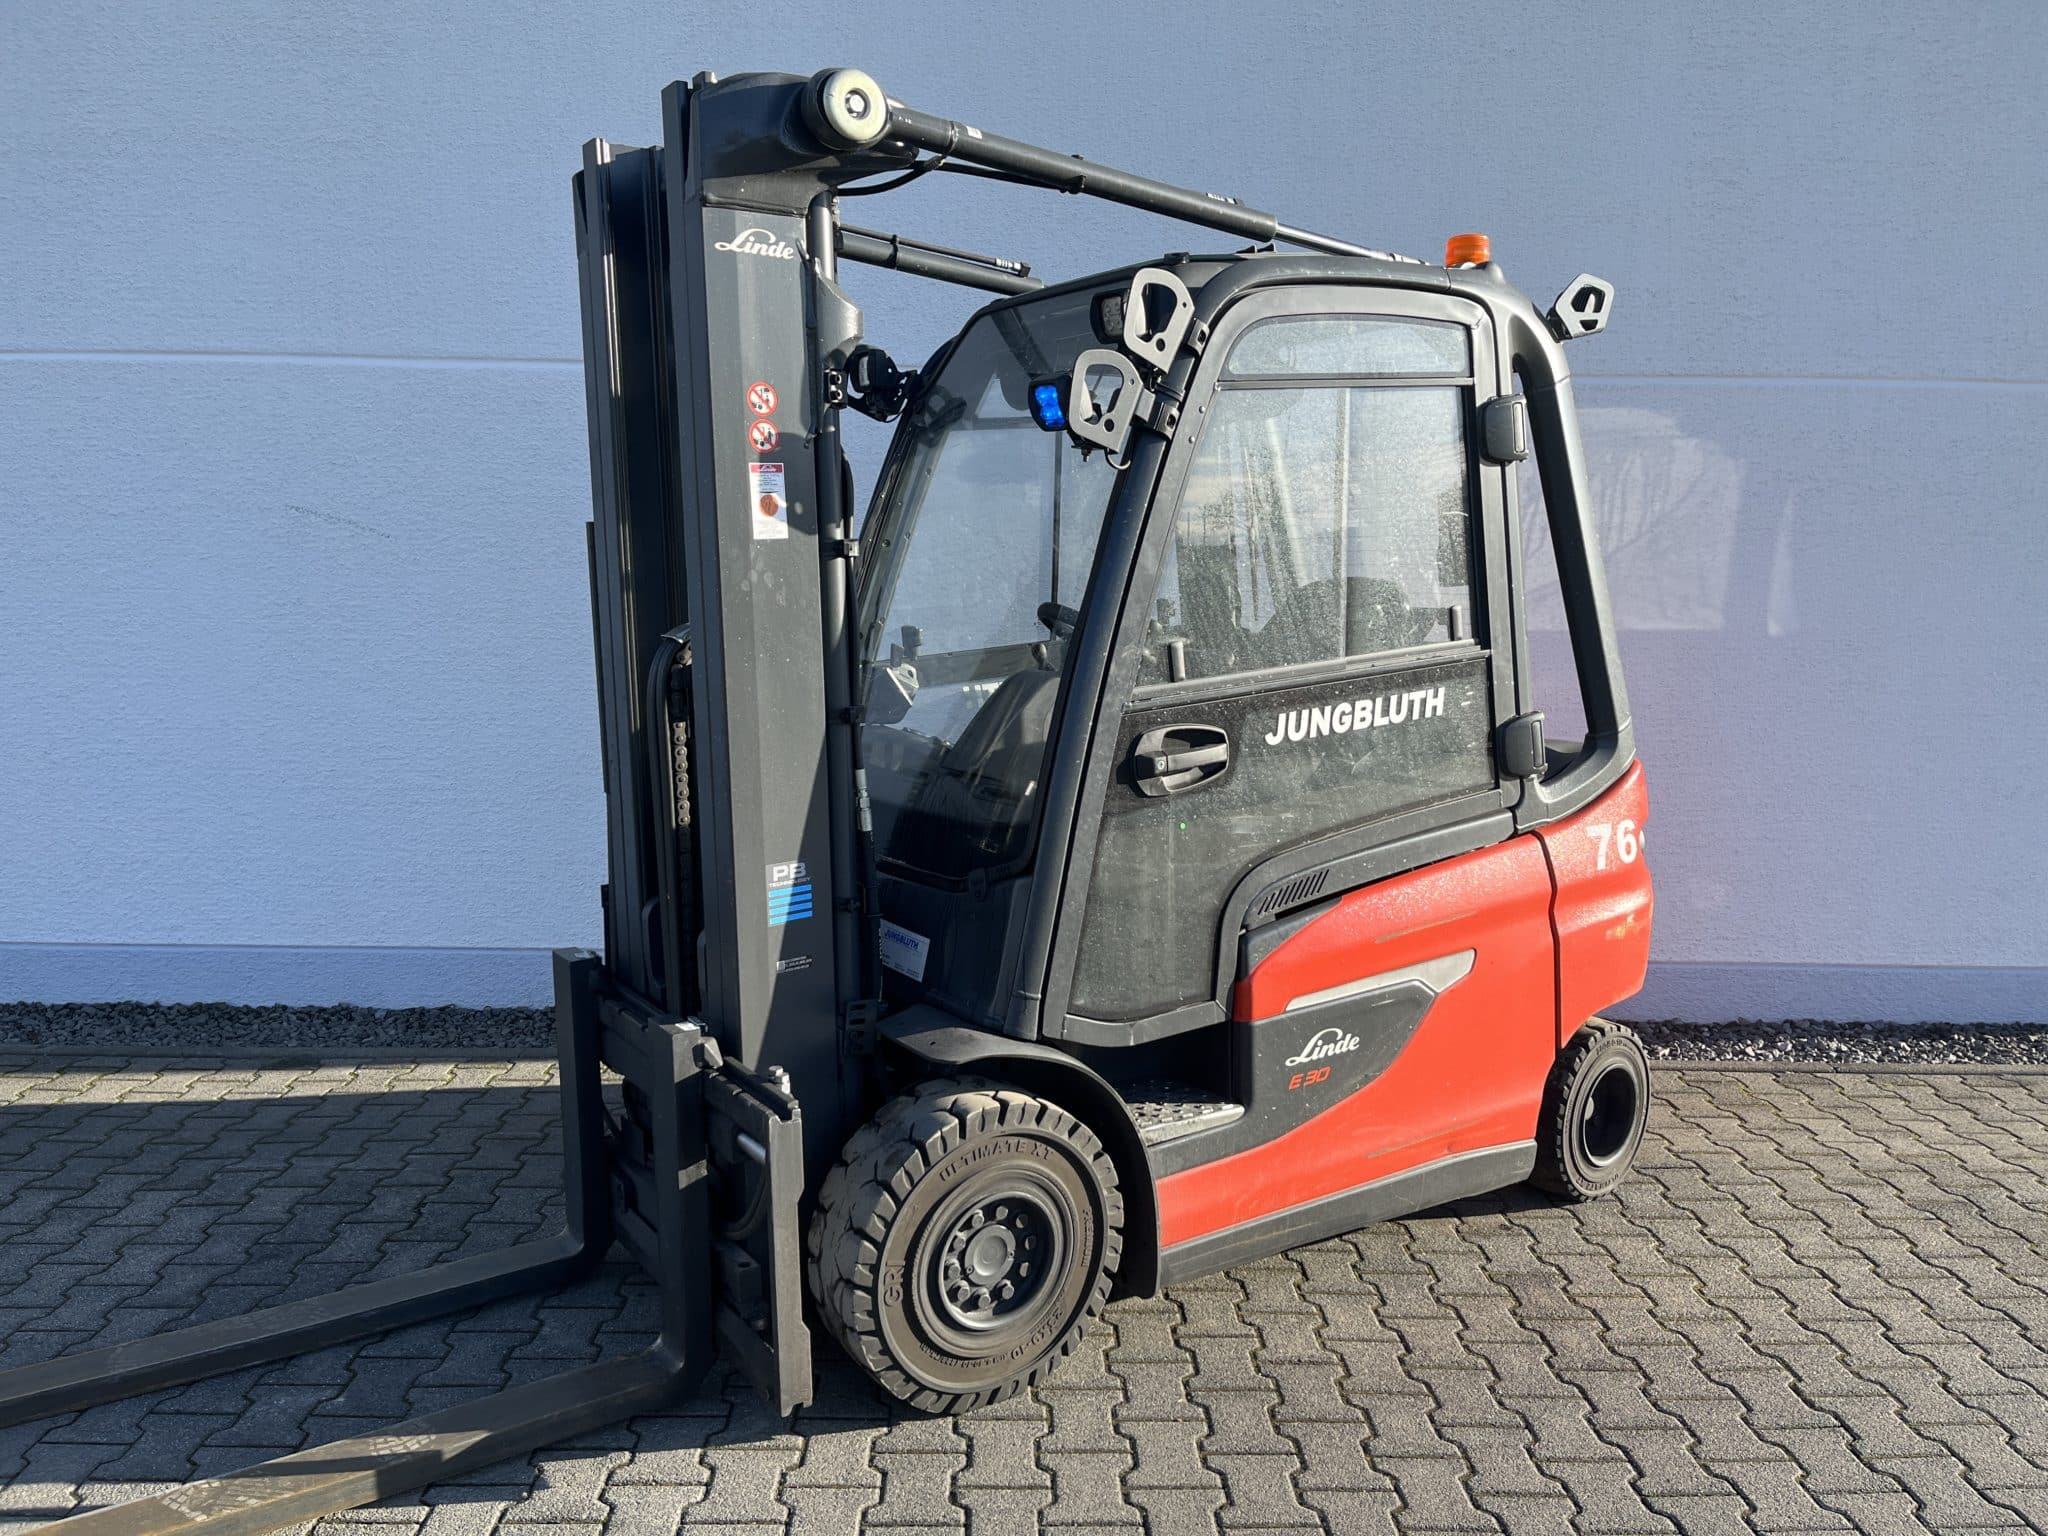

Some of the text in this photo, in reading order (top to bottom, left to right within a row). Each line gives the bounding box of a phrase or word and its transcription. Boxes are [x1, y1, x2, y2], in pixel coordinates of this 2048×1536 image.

[714, 228, 794, 260] Linde
[1264, 686, 1446, 746] JUNGBLUTH
[1586, 819, 1646, 870] 76
[773, 862, 806, 881] PB
[1285, 1027, 1360, 1067] Linde
[1289, 1066, 1332, 1090] E 30
[939, 1139, 1026, 1182] ULTIMATE
[883, 1260, 904, 1307] GRI
